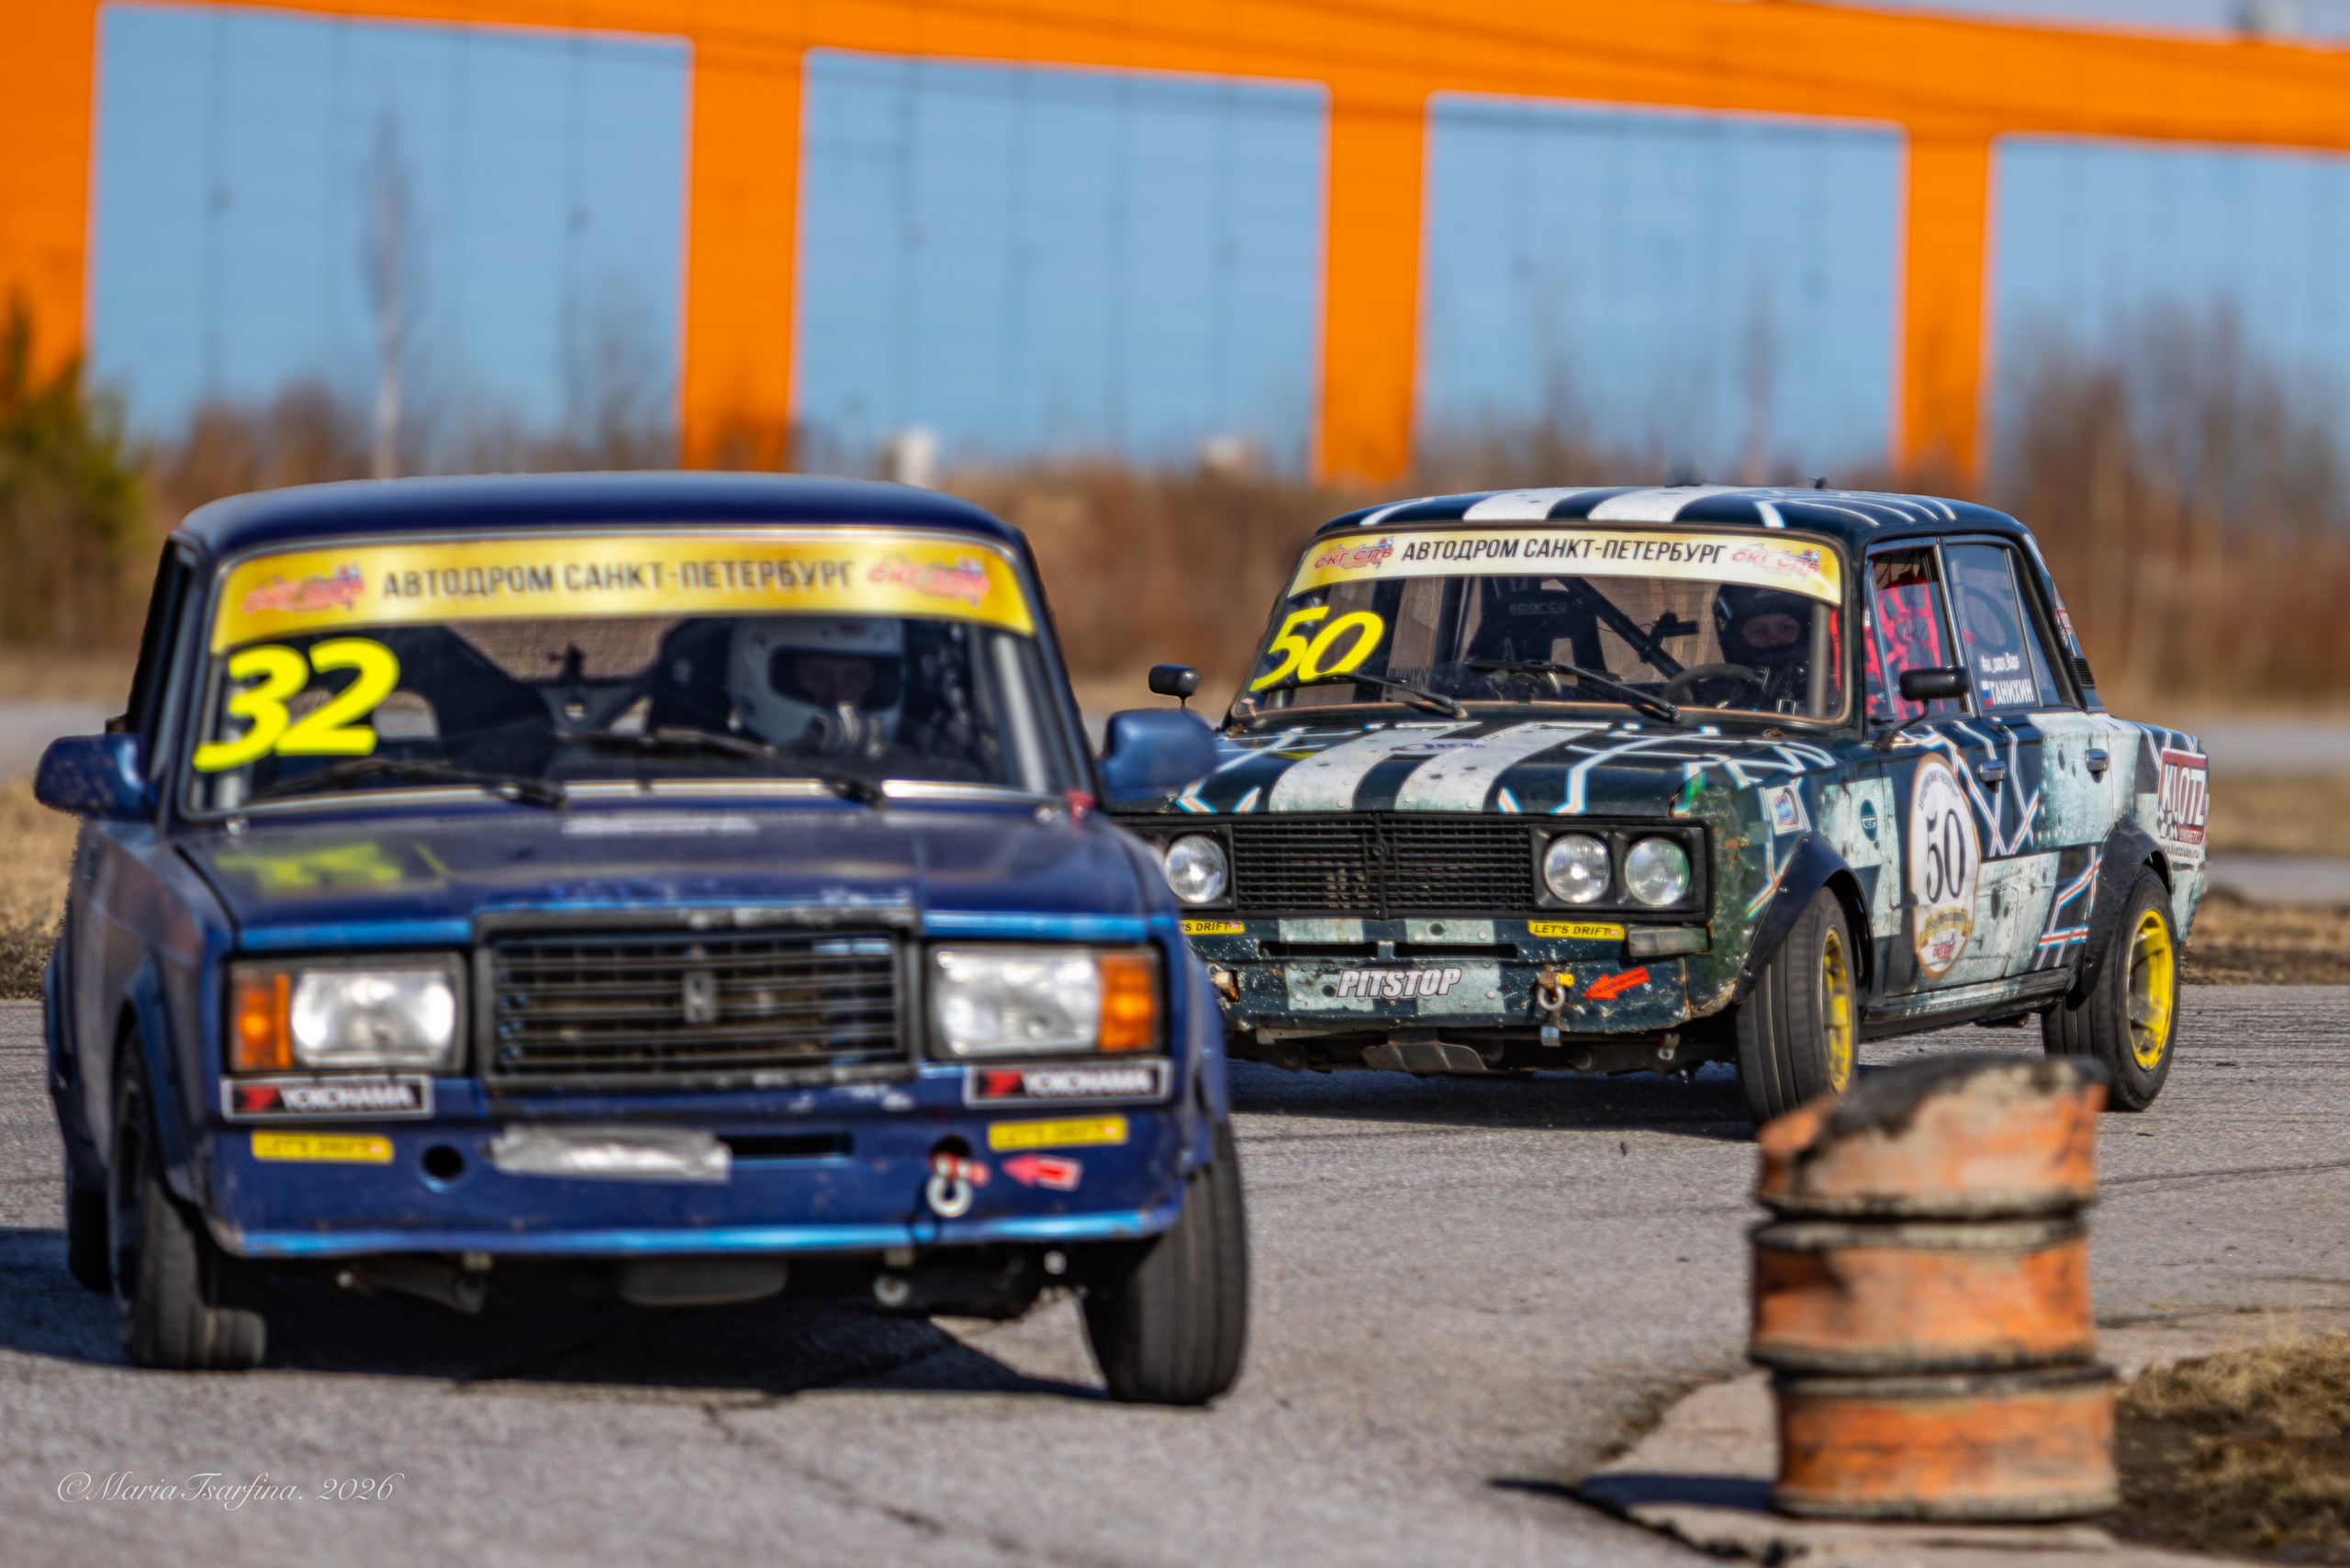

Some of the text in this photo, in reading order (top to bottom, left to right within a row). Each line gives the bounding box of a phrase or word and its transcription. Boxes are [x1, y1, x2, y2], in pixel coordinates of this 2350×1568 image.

[1400, 538, 1728, 565] АВТОДРОМ САНКТ-ПЕТЕРБУРГ
[382, 564, 552, 598] АВТОДРОМ
[563, 560, 854, 593] САНКТ-ПЕТЕРБУРГ
[1248, 605, 1385, 692] 50
[192, 636, 400, 772] 32
[2162, 762, 2207, 825] KLOTZ
[1926, 808, 1966, 904] 50
[1196, 922, 1230, 932] DRIFT
[1534, 924, 1570, 935] LET'S
[1572, 925, 1610, 936] DRIFT
[1336, 967, 1463, 999] PITSTOP
[1021, 1069, 1155, 1096] YOKOHAMA
[279, 1085, 416, 1113] YOKOHAMA
